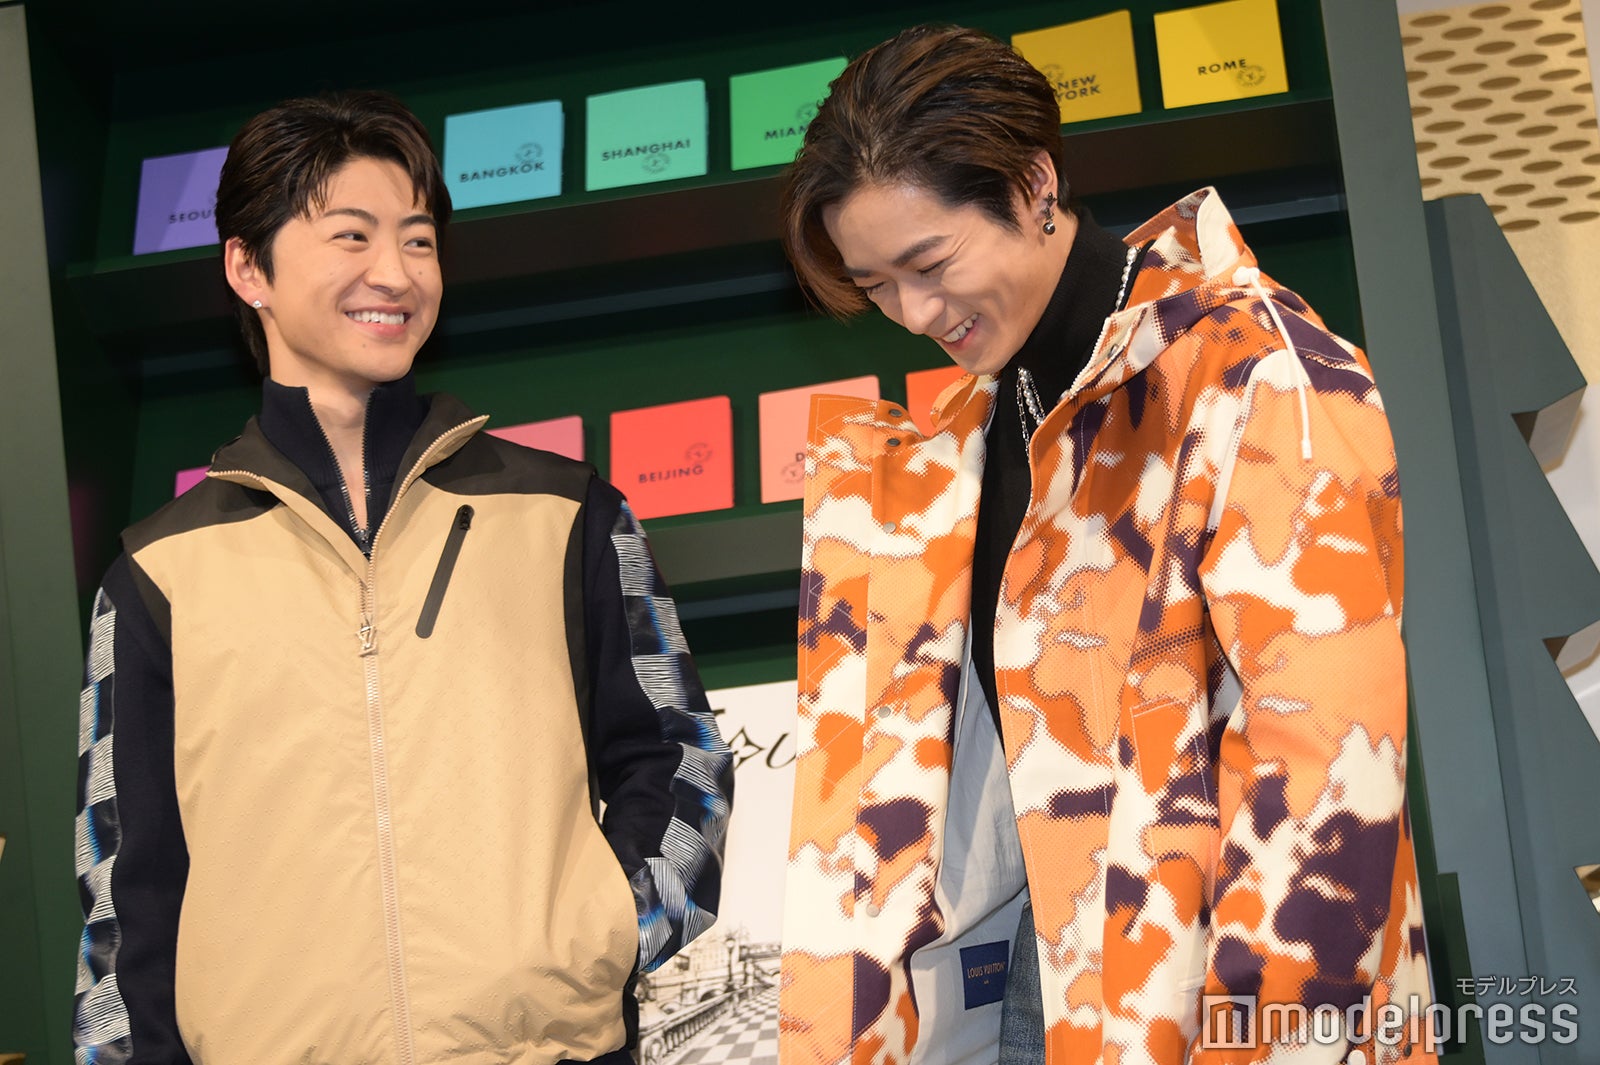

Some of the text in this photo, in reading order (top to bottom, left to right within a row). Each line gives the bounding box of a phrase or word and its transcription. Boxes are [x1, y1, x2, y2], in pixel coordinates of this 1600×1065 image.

[1197, 58, 1247, 76] ROME
[1057, 74, 1096, 90] NEW
[1054, 84, 1101, 102] YORK
[602, 138, 691, 162] SHANGHAI
[459, 161, 545, 183] BANGKOK
[168, 209, 213, 225] SEOU
[638, 465, 704, 484] BEIJING
[967, 966, 983, 979] LOUIS
